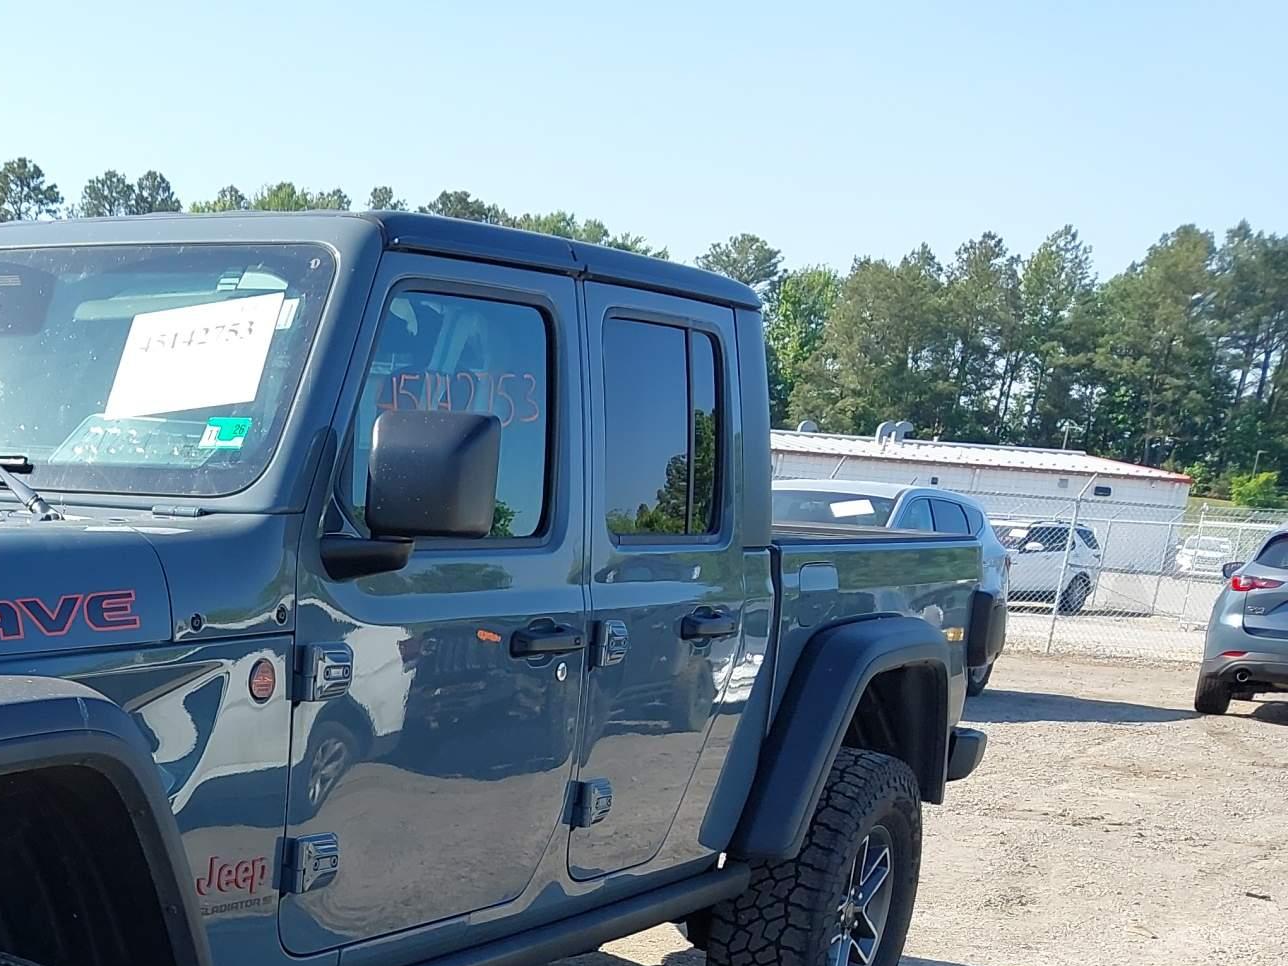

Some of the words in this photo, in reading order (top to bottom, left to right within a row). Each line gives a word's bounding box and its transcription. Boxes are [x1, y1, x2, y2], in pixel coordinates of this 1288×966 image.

[139, 320, 254, 353] 45142753
[232, 423, 247, 435] 26
[195, 855, 268, 896] Jeep
